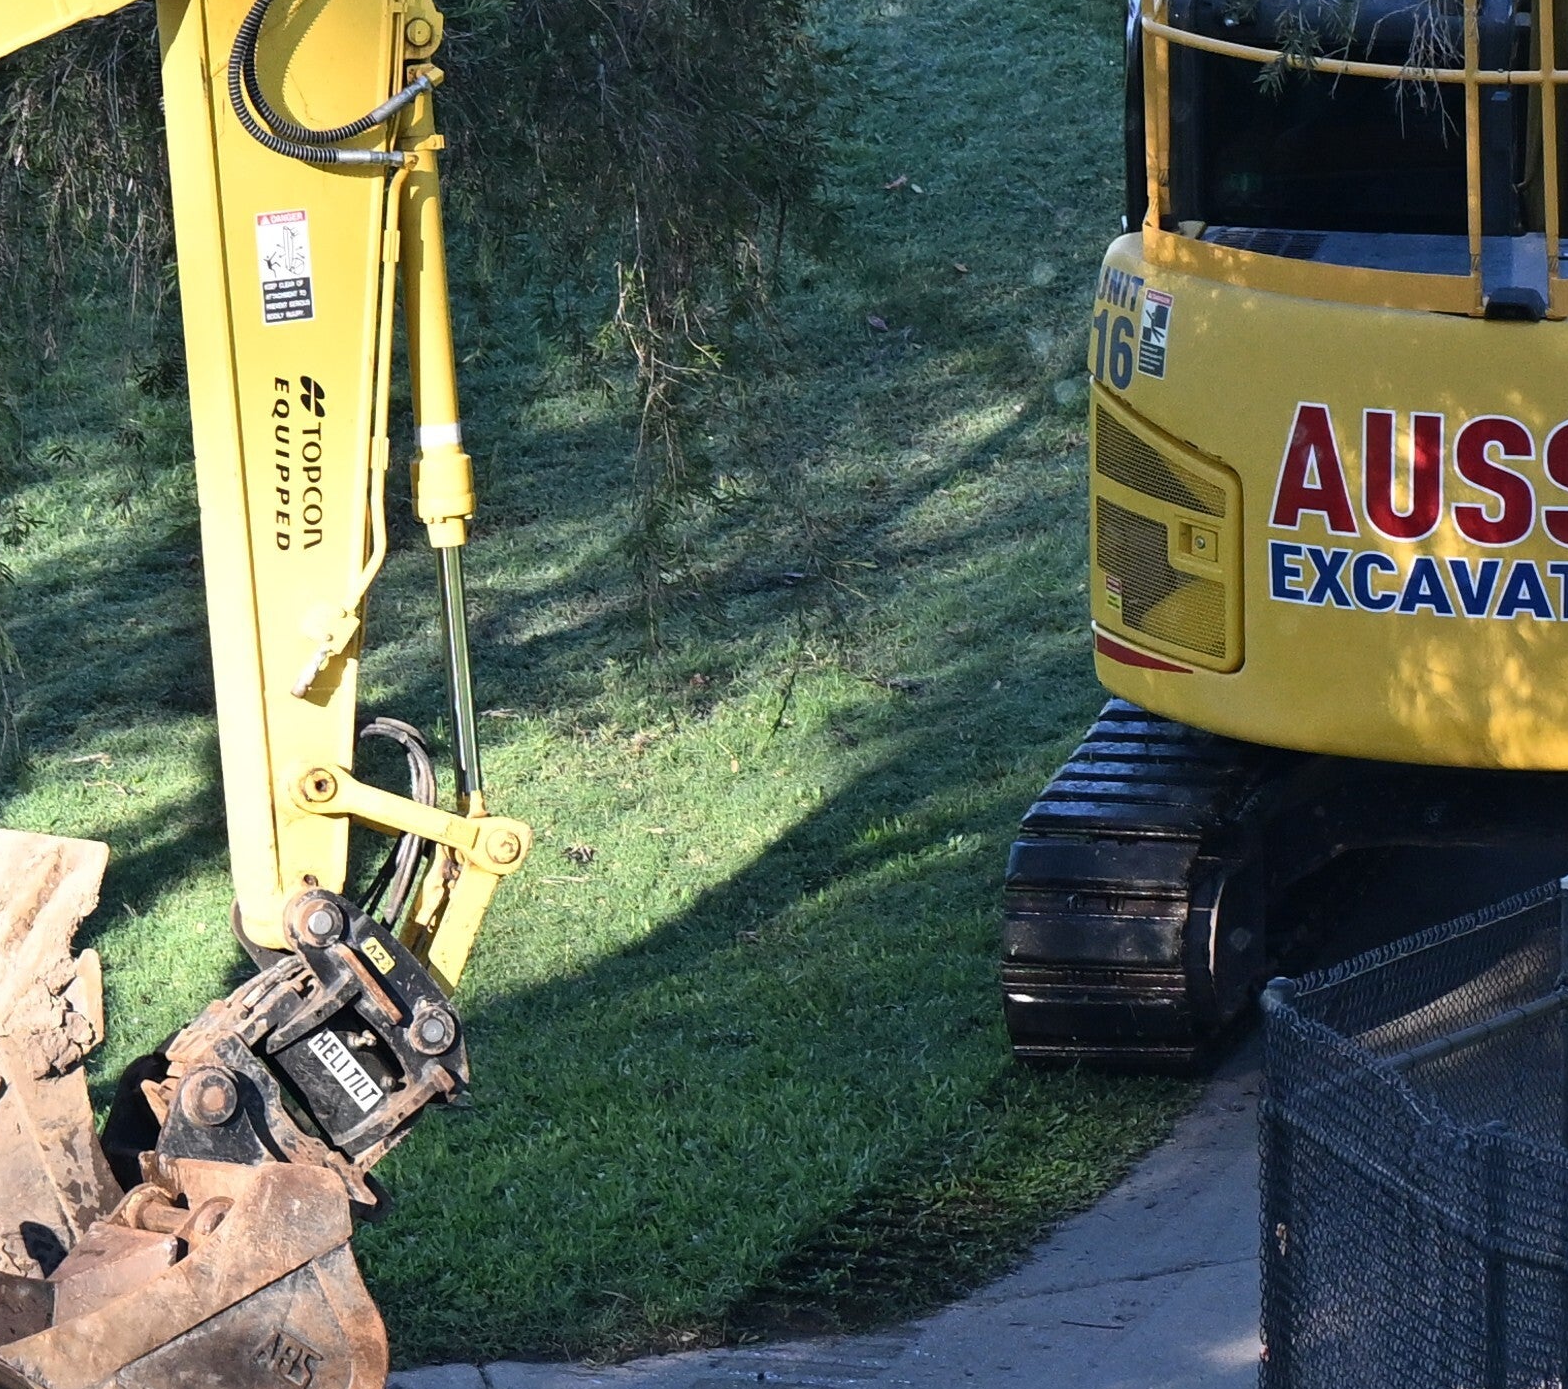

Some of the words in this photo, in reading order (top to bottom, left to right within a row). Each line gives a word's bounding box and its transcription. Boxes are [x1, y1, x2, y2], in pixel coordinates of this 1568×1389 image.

[1098, 266, 1145, 312] UNIT
[1093, 308, 1135, 390] 16
[271, 377, 290, 551] EQUIPPED
[302, 422, 323, 550] TOPCON
